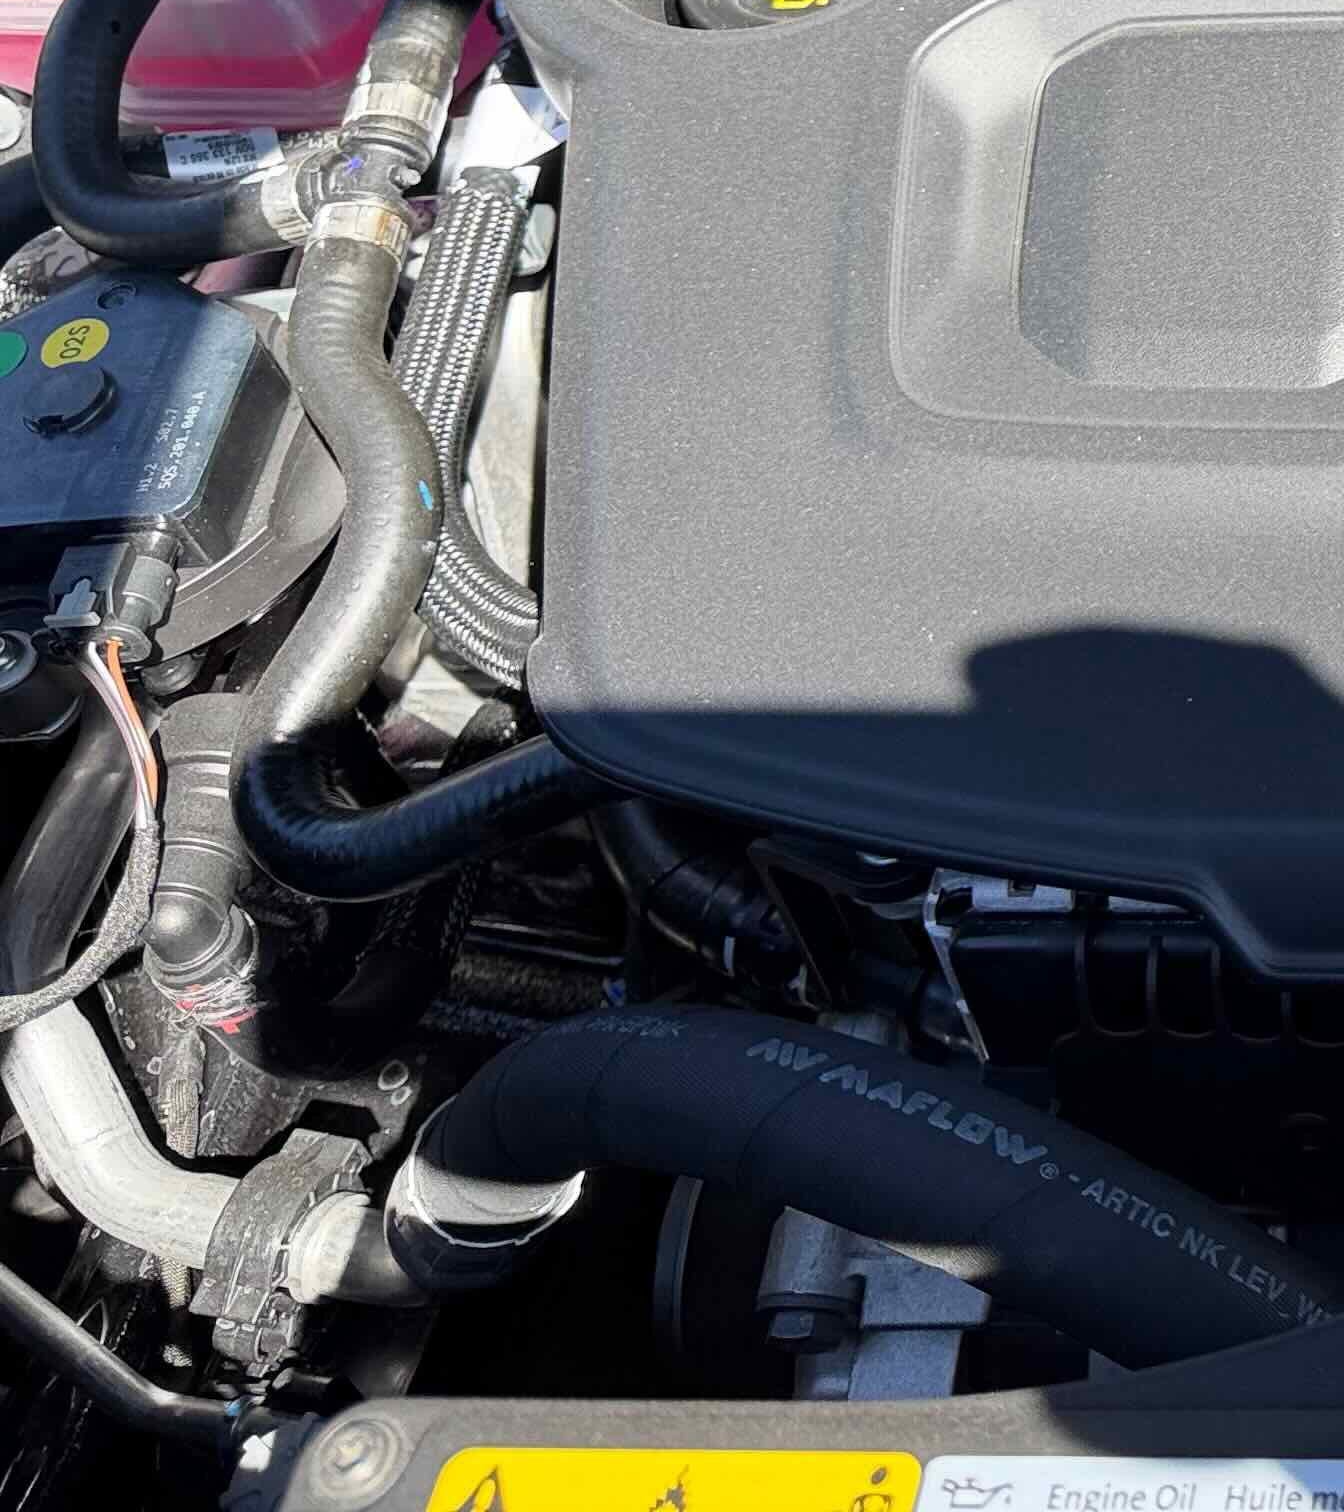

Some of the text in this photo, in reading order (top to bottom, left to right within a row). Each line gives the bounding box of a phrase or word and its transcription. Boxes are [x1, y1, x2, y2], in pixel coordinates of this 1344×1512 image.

[1081, 1178, 1176, 1237] ARTIC
[1179, 1226, 1226, 1270] NK
[1046, 1481, 1147, 1512] Engine
[1155, 1483, 1198, 1511] Oil
[1223, 1483, 1303, 1511] Huile
